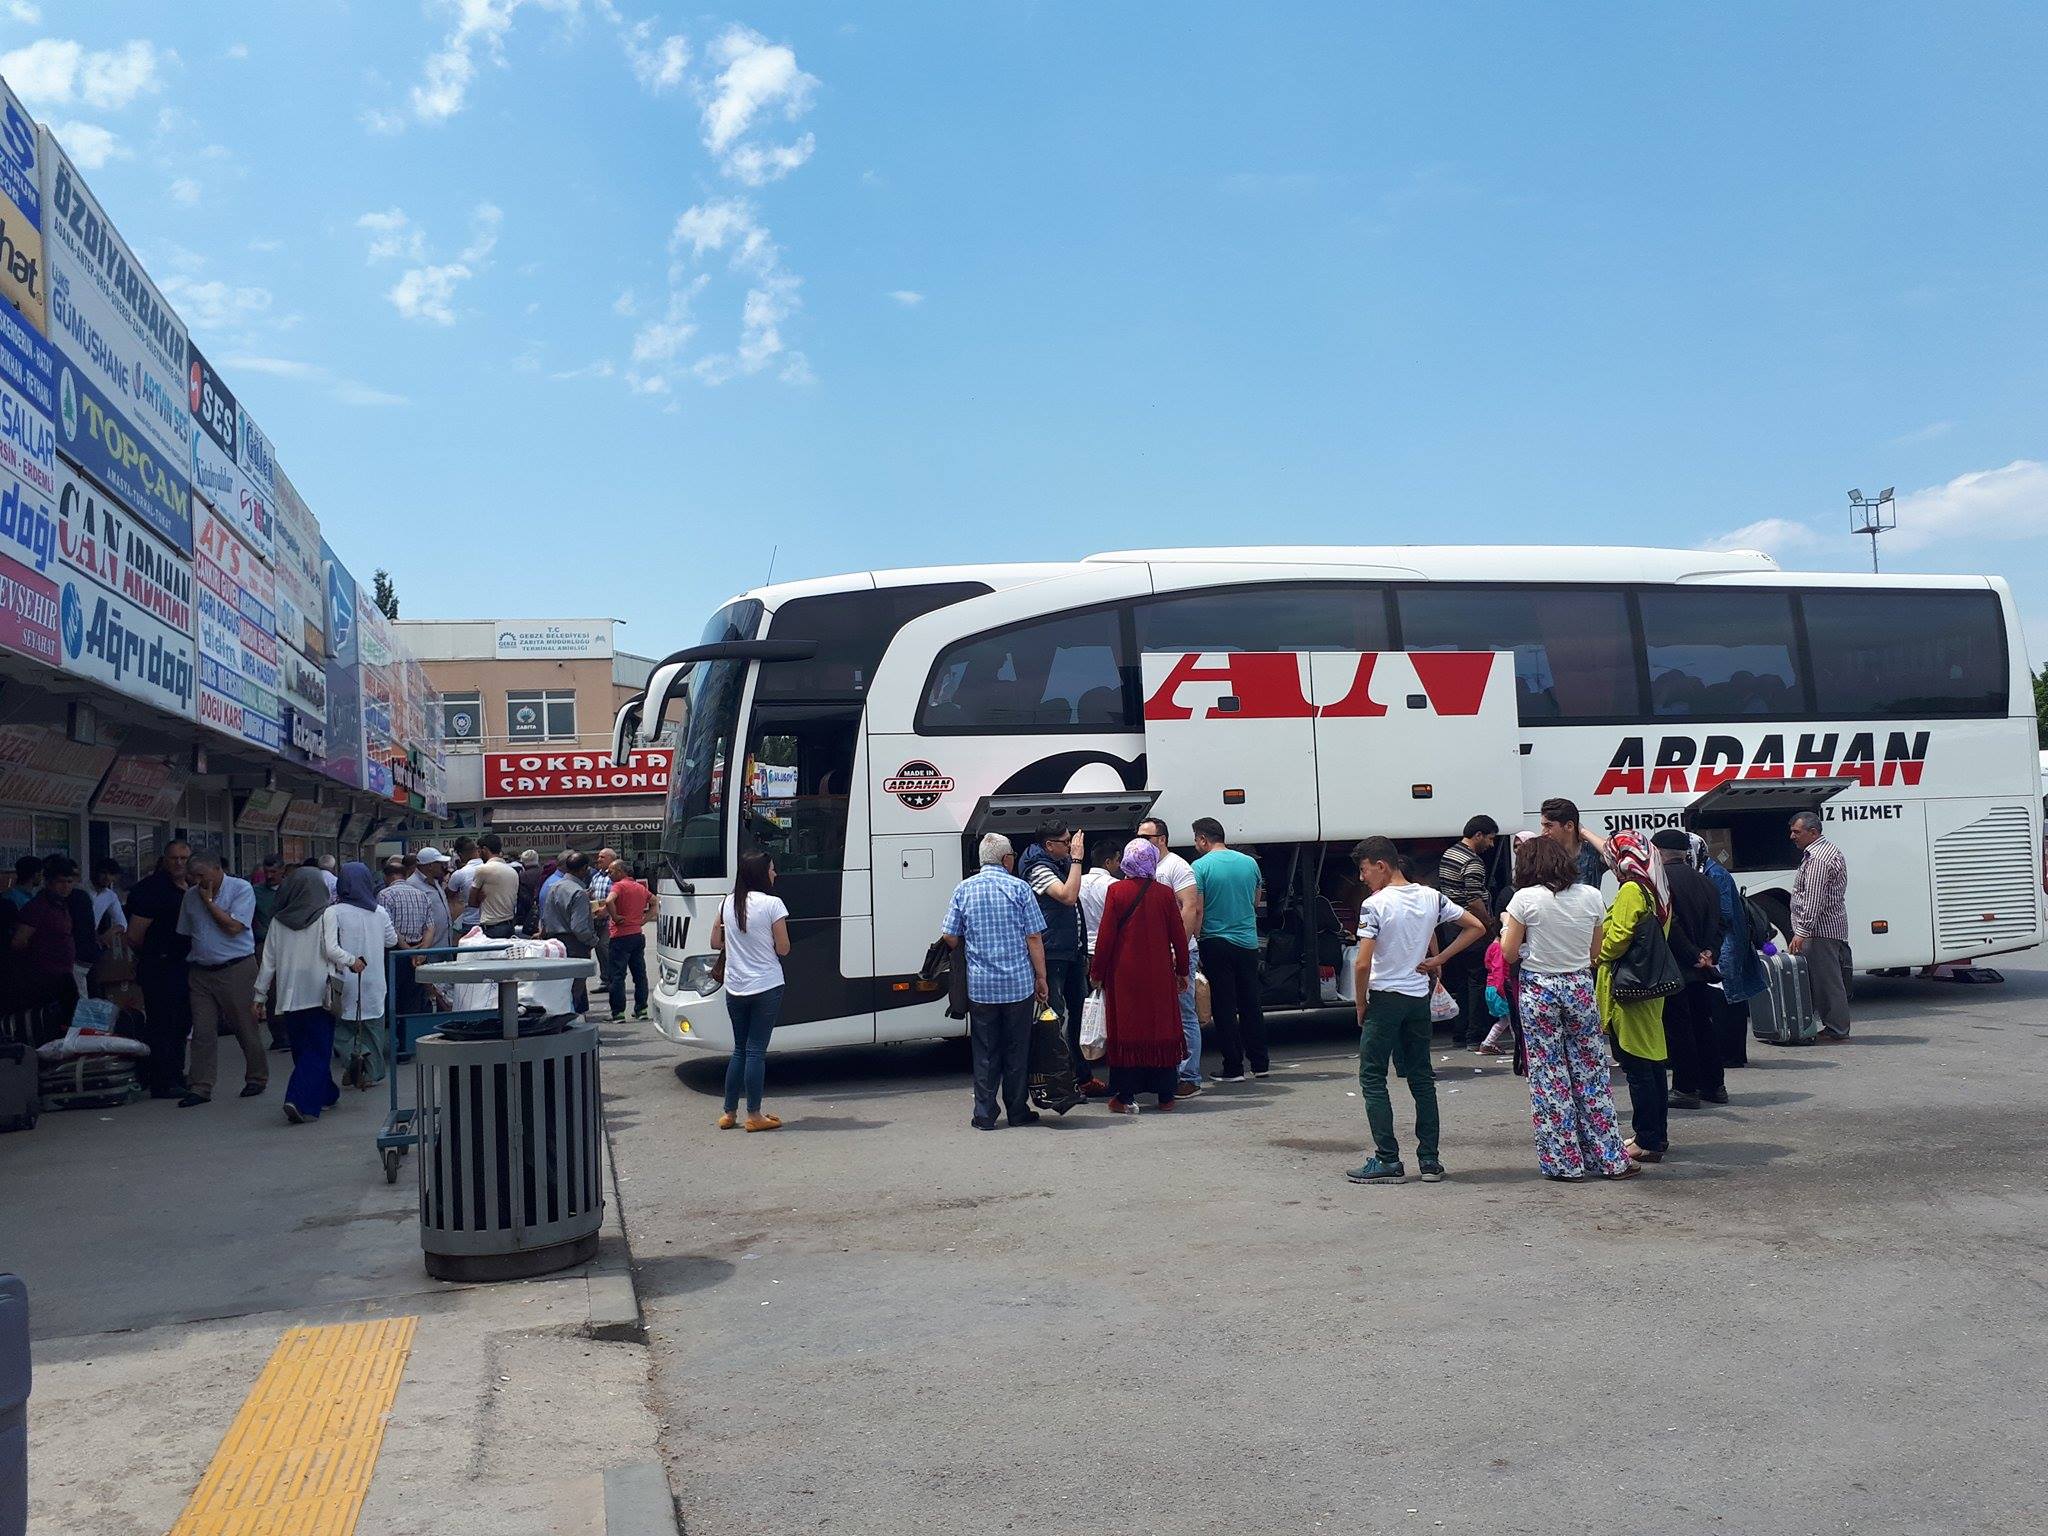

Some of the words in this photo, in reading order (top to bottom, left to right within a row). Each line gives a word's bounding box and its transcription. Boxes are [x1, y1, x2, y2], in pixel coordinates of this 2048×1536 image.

[202, 382, 233, 445] SES
[82, 395, 188, 522] TOPÇAM
[59, 482, 122, 586] CAN
[123, 530, 191, 632] ARDAHAN
[200, 517, 240, 576] ATS
[22, 627, 56, 657] SEYAHAT
[224, 701, 242, 731] KARS
[500, 753, 668, 773] LOKANTA
[1594, 731, 1931, 796] ARDAHAN
[500, 776, 555, 792] ÇAY
[560, 773, 668, 790] SALONU
[888, 780, 950, 790] ARDAHAN
[508, 823, 566, 833] LOKANTA
[568, 823, 584, 832] VE
[587, 823, 609, 833] ÇAY
[611, 822, 660, 831] SALONU
